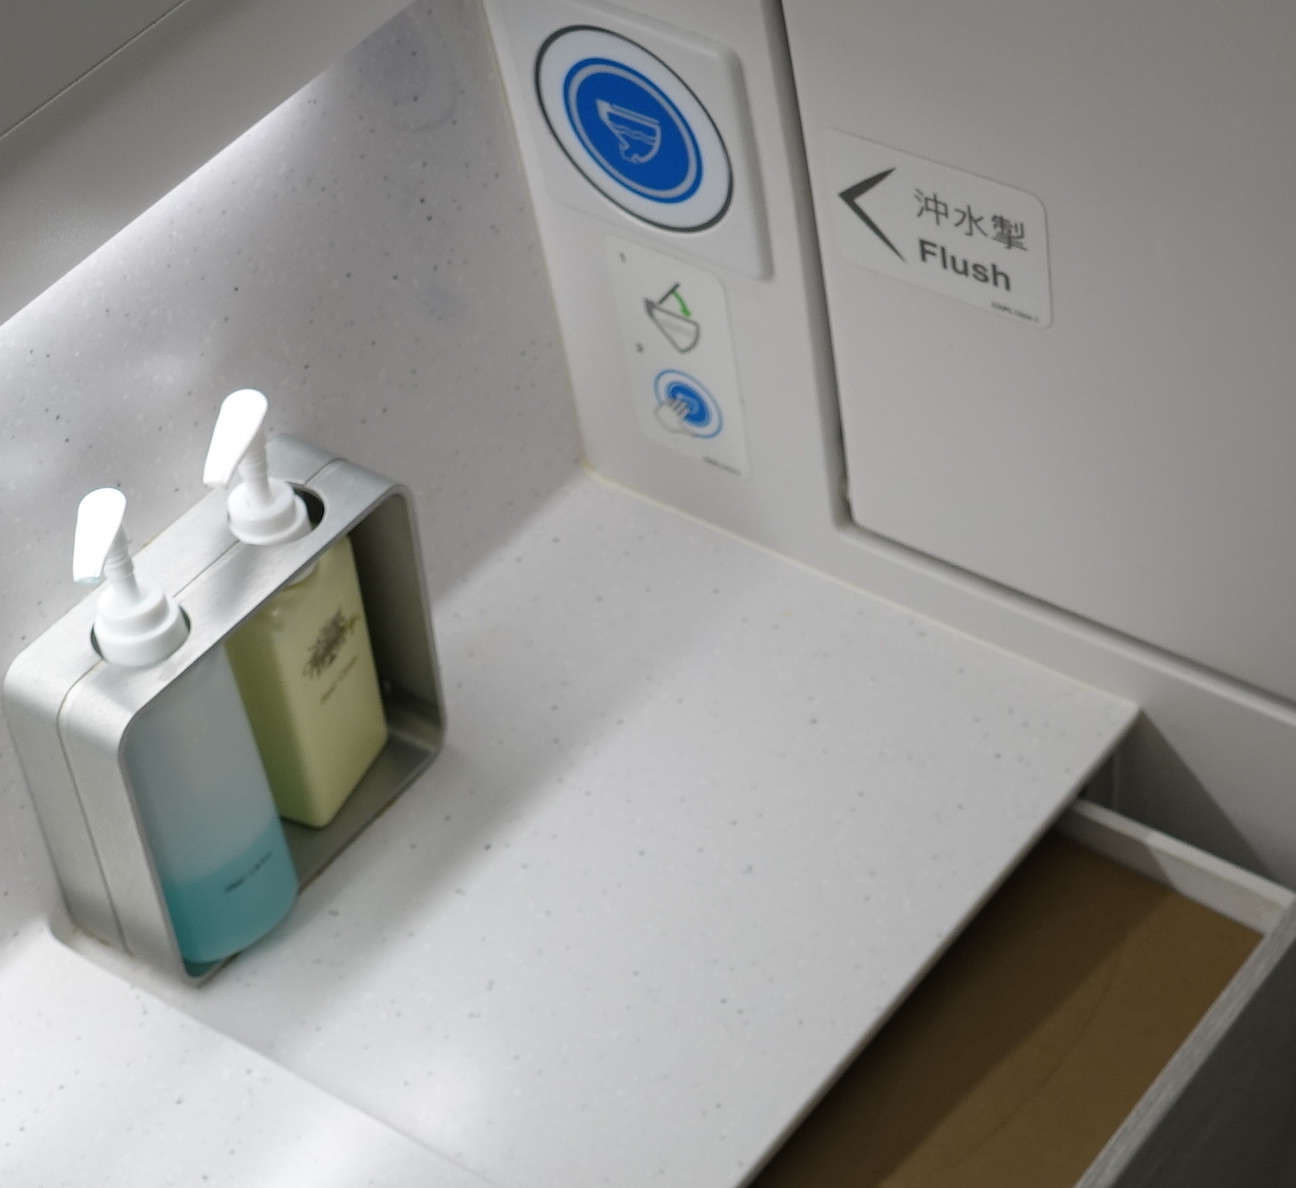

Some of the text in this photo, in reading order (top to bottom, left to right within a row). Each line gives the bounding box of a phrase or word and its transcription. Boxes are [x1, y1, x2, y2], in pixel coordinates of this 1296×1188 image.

[914, 188, 1027, 250] 沖水掣
[919, 238, 1011, 291] Flush
